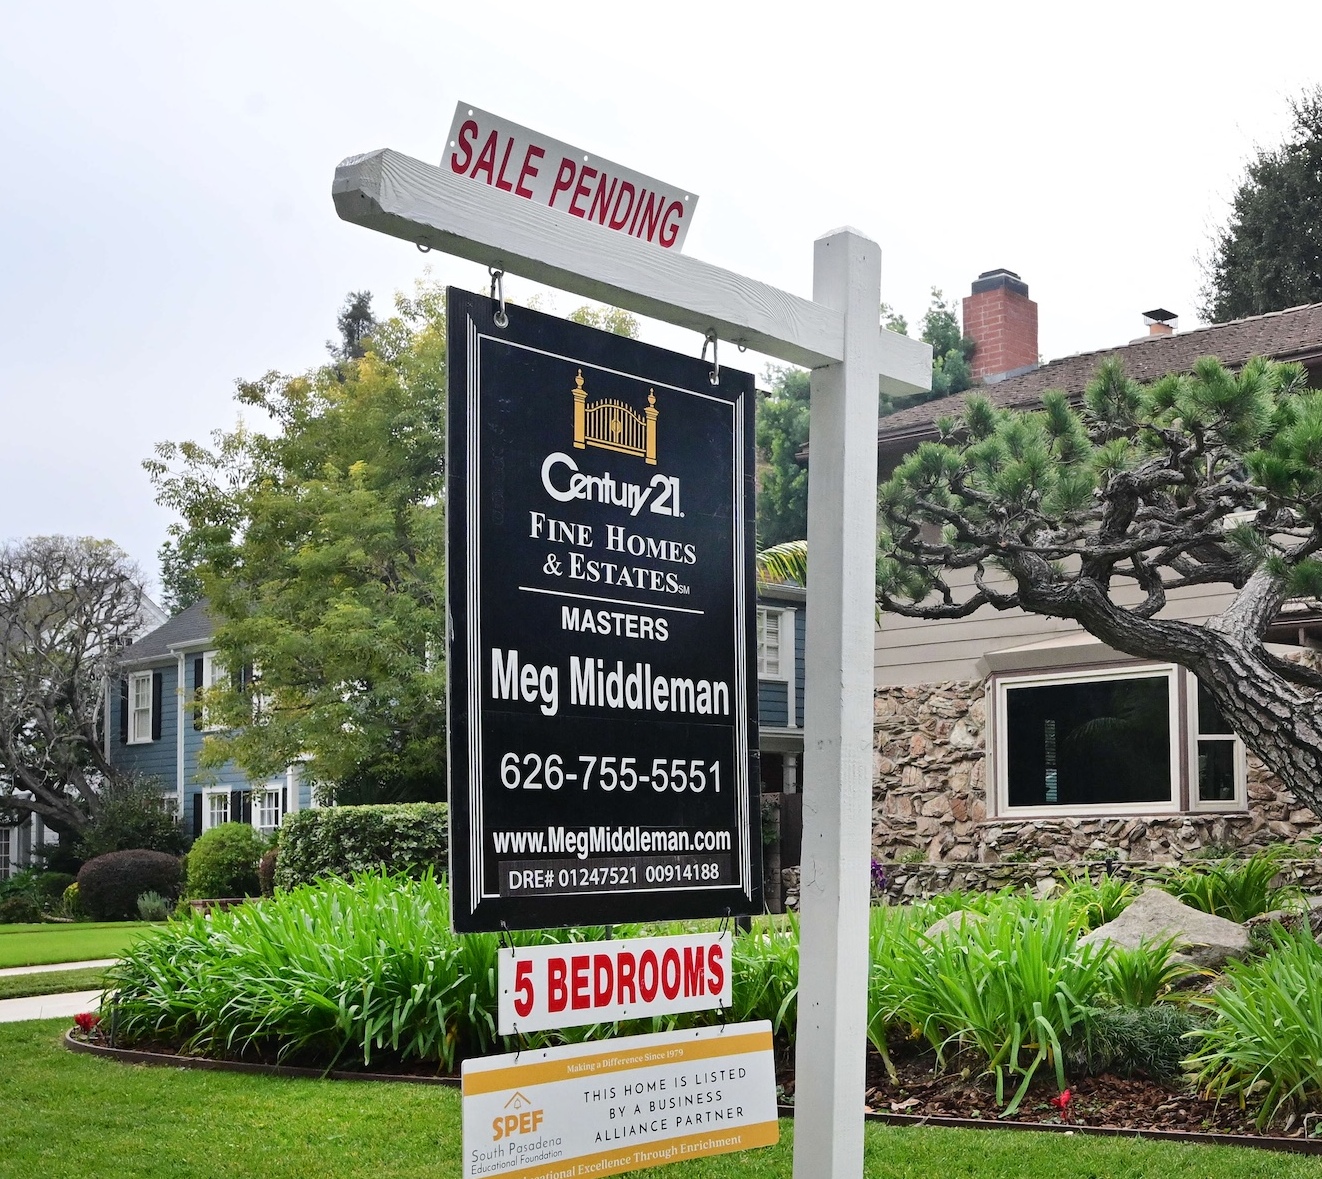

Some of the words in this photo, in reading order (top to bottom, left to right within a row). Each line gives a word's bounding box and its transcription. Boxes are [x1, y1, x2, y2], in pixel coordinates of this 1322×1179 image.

[451, 119, 545, 200] SALE
[548, 157, 684, 248] PENDING
[541, 452, 652, 516] Century
[543, 553, 563, 577] &
[561, 606, 669, 642] MASTERS
[491, 647, 559, 717] Meg
[569, 656, 730, 716] Middleman
[500, 752, 721, 793] 626-755-5551
[493, 826, 731, 860] www.MegMiddleman.com
[509, 869, 554, 890] DRE#
[558, 866, 637, 887] 01247521
[645, 863, 720, 883] 00914188
[513, 960, 535, 1018] 5
[547, 943, 725, 1014] BEDROOMS
[567, 1062, 595, 1073] Making
[602, 1055, 643, 1068] Difference
[644, 1052, 665, 1062] Since
[666, 1049, 684, 1058] 1979
[584, 1087, 617, 1103] THIS
[624, 1079, 666, 1096] HOME
[674, 1076, 687, 1088] IS
[695, 1067, 746, 1085] LISTED
[609, 1105, 625, 1119] BY
[633, 1104, 641, 1115] A
[649, 1090, 722, 1112] BUSINESS
[492, 1109, 544, 1141] SPEF
[594, 1118, 667, 1143] ALLIANCE
[676, 1106, 744, 1128] PARTNER
[471, 1144, 505, 1162] South
[509, 1136, 562, 1155] Pasadena
[471, 1156, 518, 1175] Educational
[520, 1150, 563, 1164] Foundation
[578, 1155, 631, 1175] Excellence
[633, 1145, 678, 1163] Through
[680, 1136, 742, 1153] Enrichment
